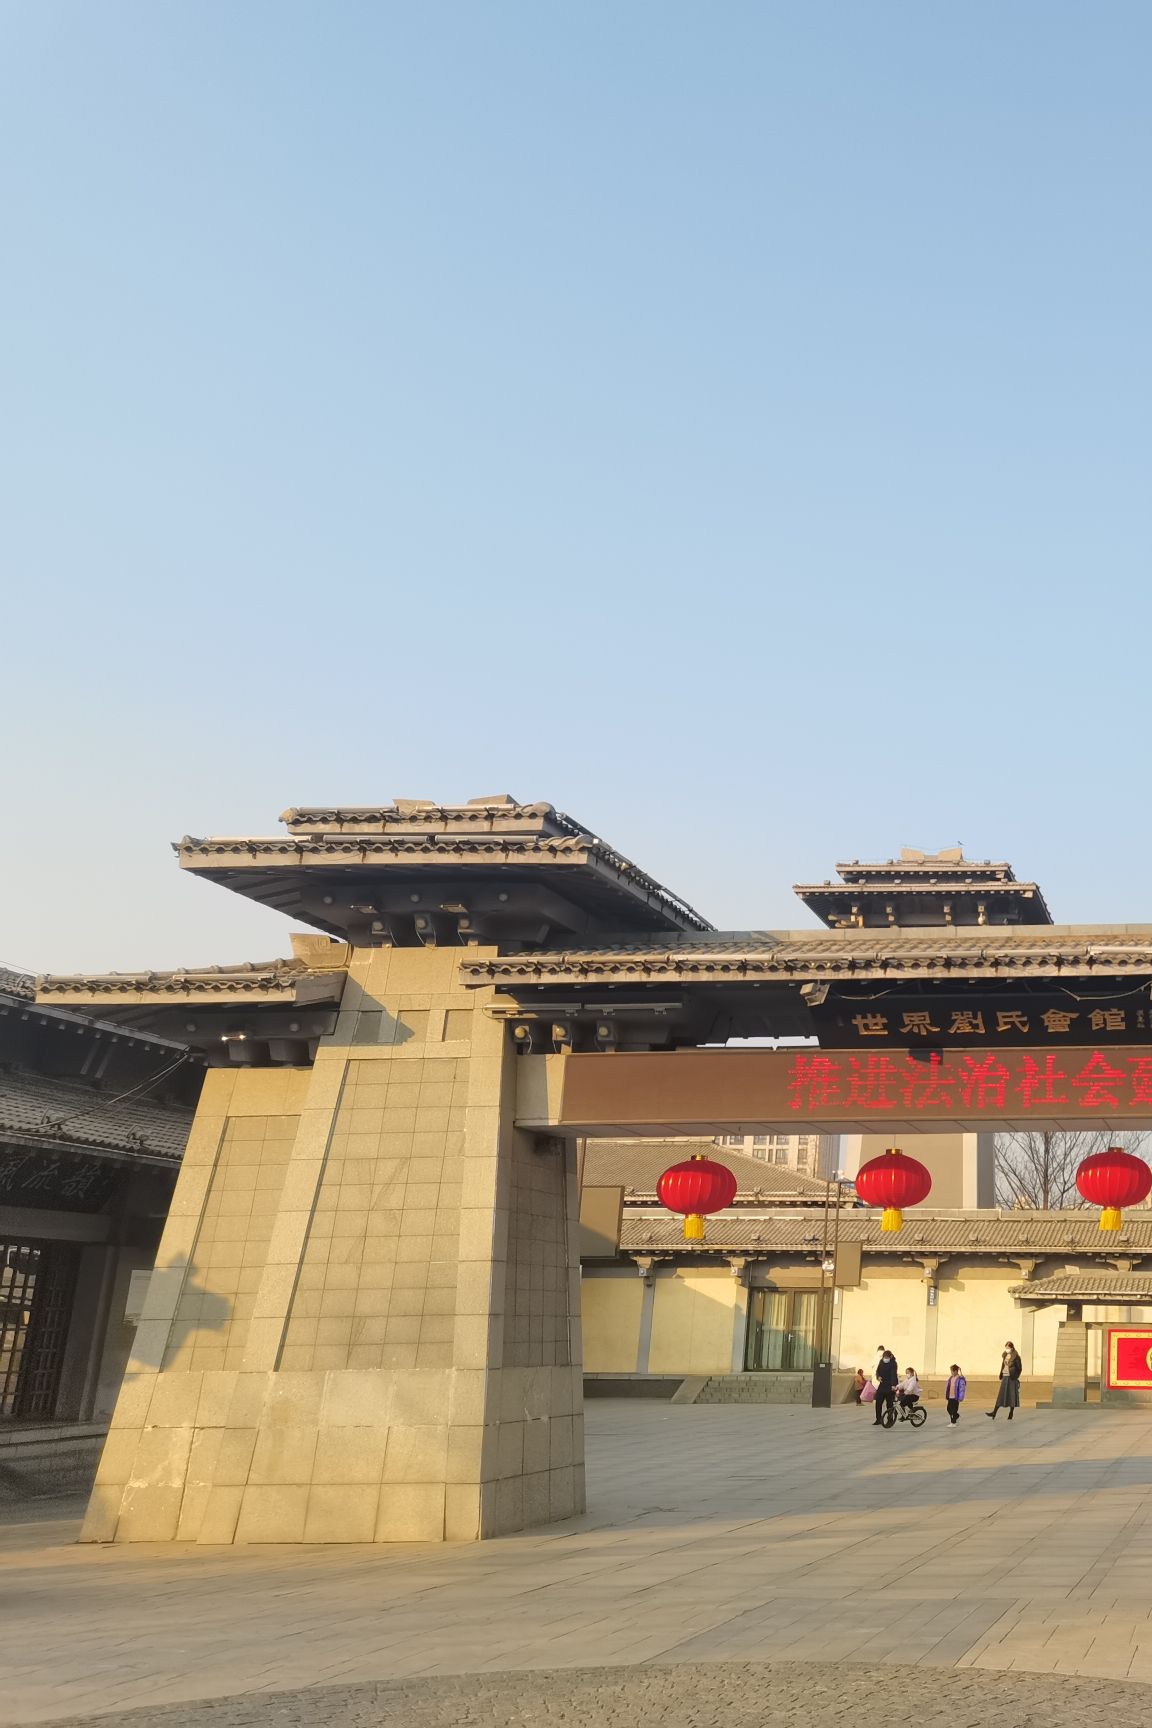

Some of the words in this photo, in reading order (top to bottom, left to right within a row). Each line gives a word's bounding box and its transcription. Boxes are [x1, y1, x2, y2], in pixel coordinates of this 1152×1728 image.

[852, 1008, 1127, 1035] 世界劉氏會館
